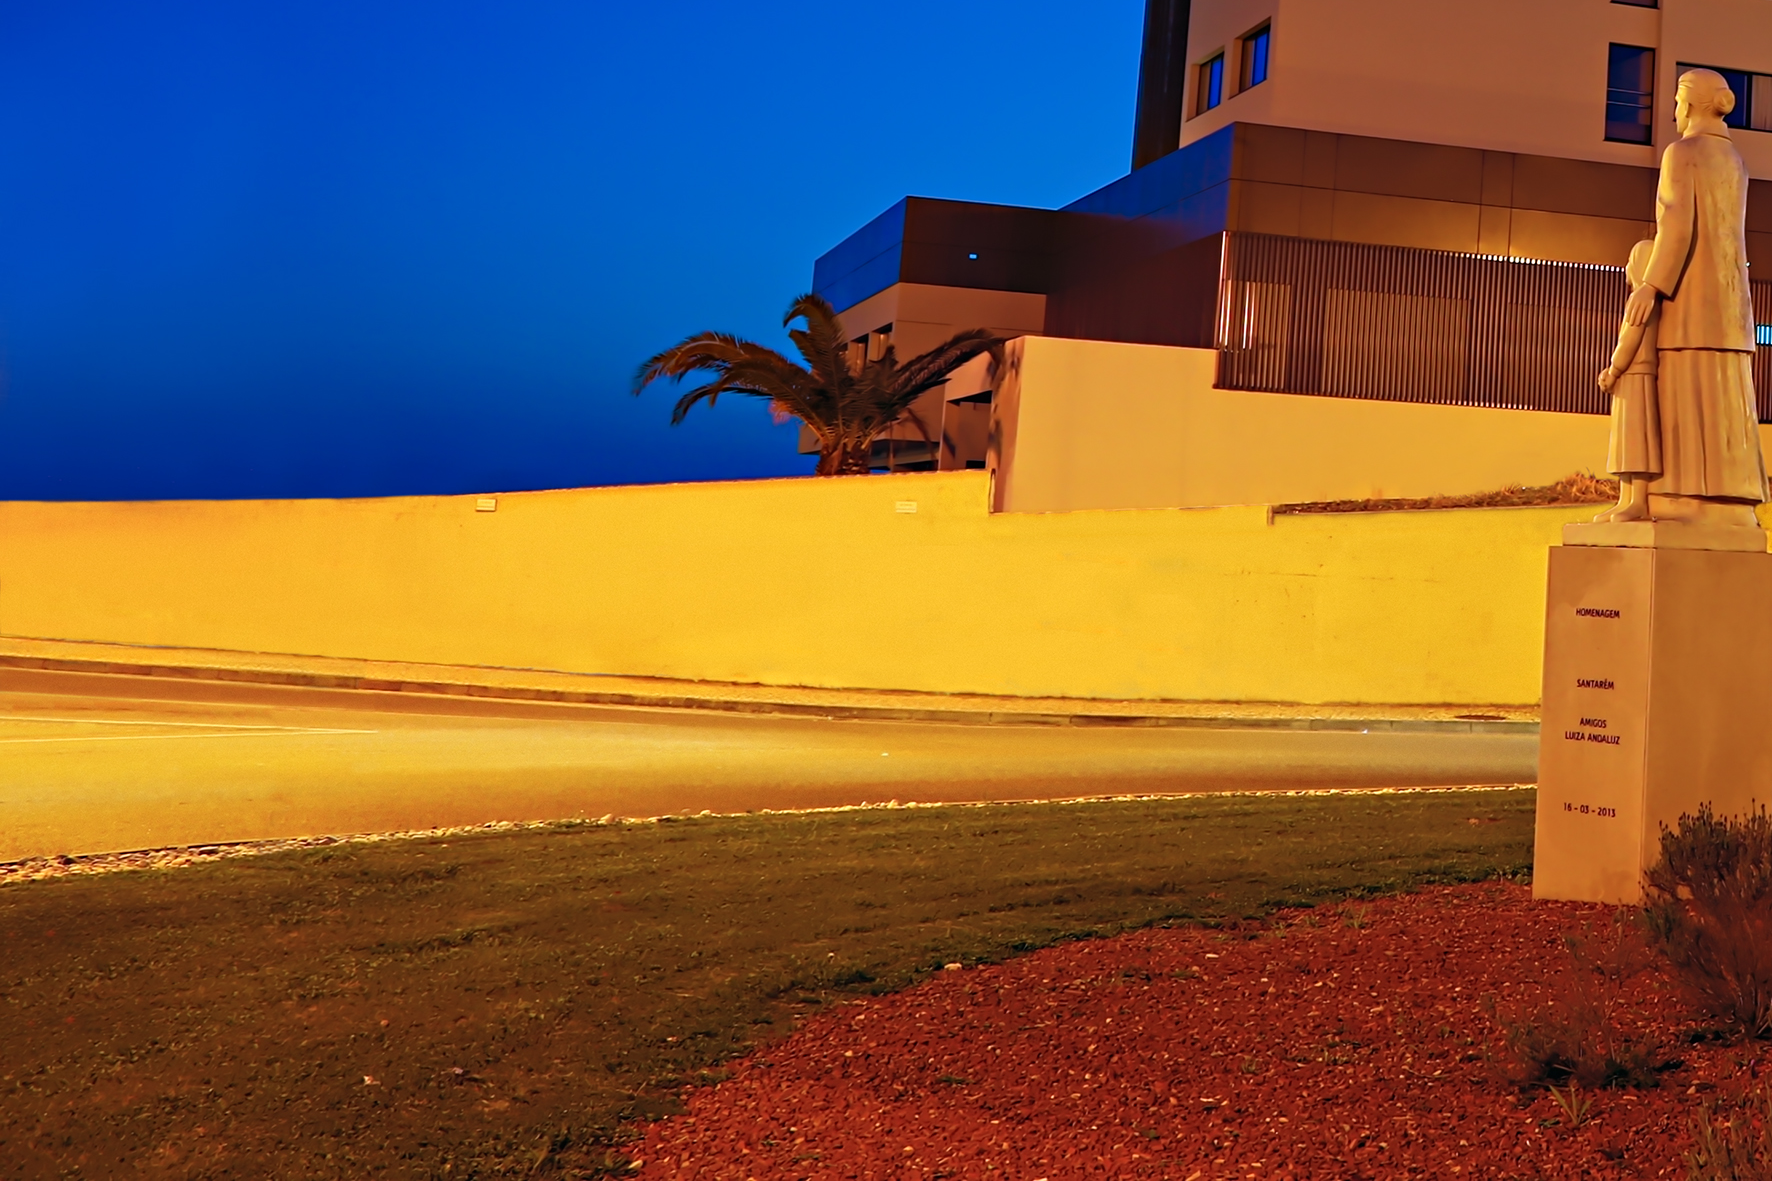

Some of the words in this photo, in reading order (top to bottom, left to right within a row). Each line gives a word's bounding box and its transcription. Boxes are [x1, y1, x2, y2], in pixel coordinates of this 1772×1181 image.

[1575, 607, 1621, 619] HOMENAGEM
[1576, 678, 1615, 690] SANTARÉM
[1579, 717, 1607, 729] AMIGOS
[1564, 730, 1586, 741] LUIZA
[1587, 733, 1621, 745] ANDALUZ
[1563, 802, 1572, 812] 16
[1580, 804, 1589, 815] 03
[1597, 806, 1616, 818] 2013
